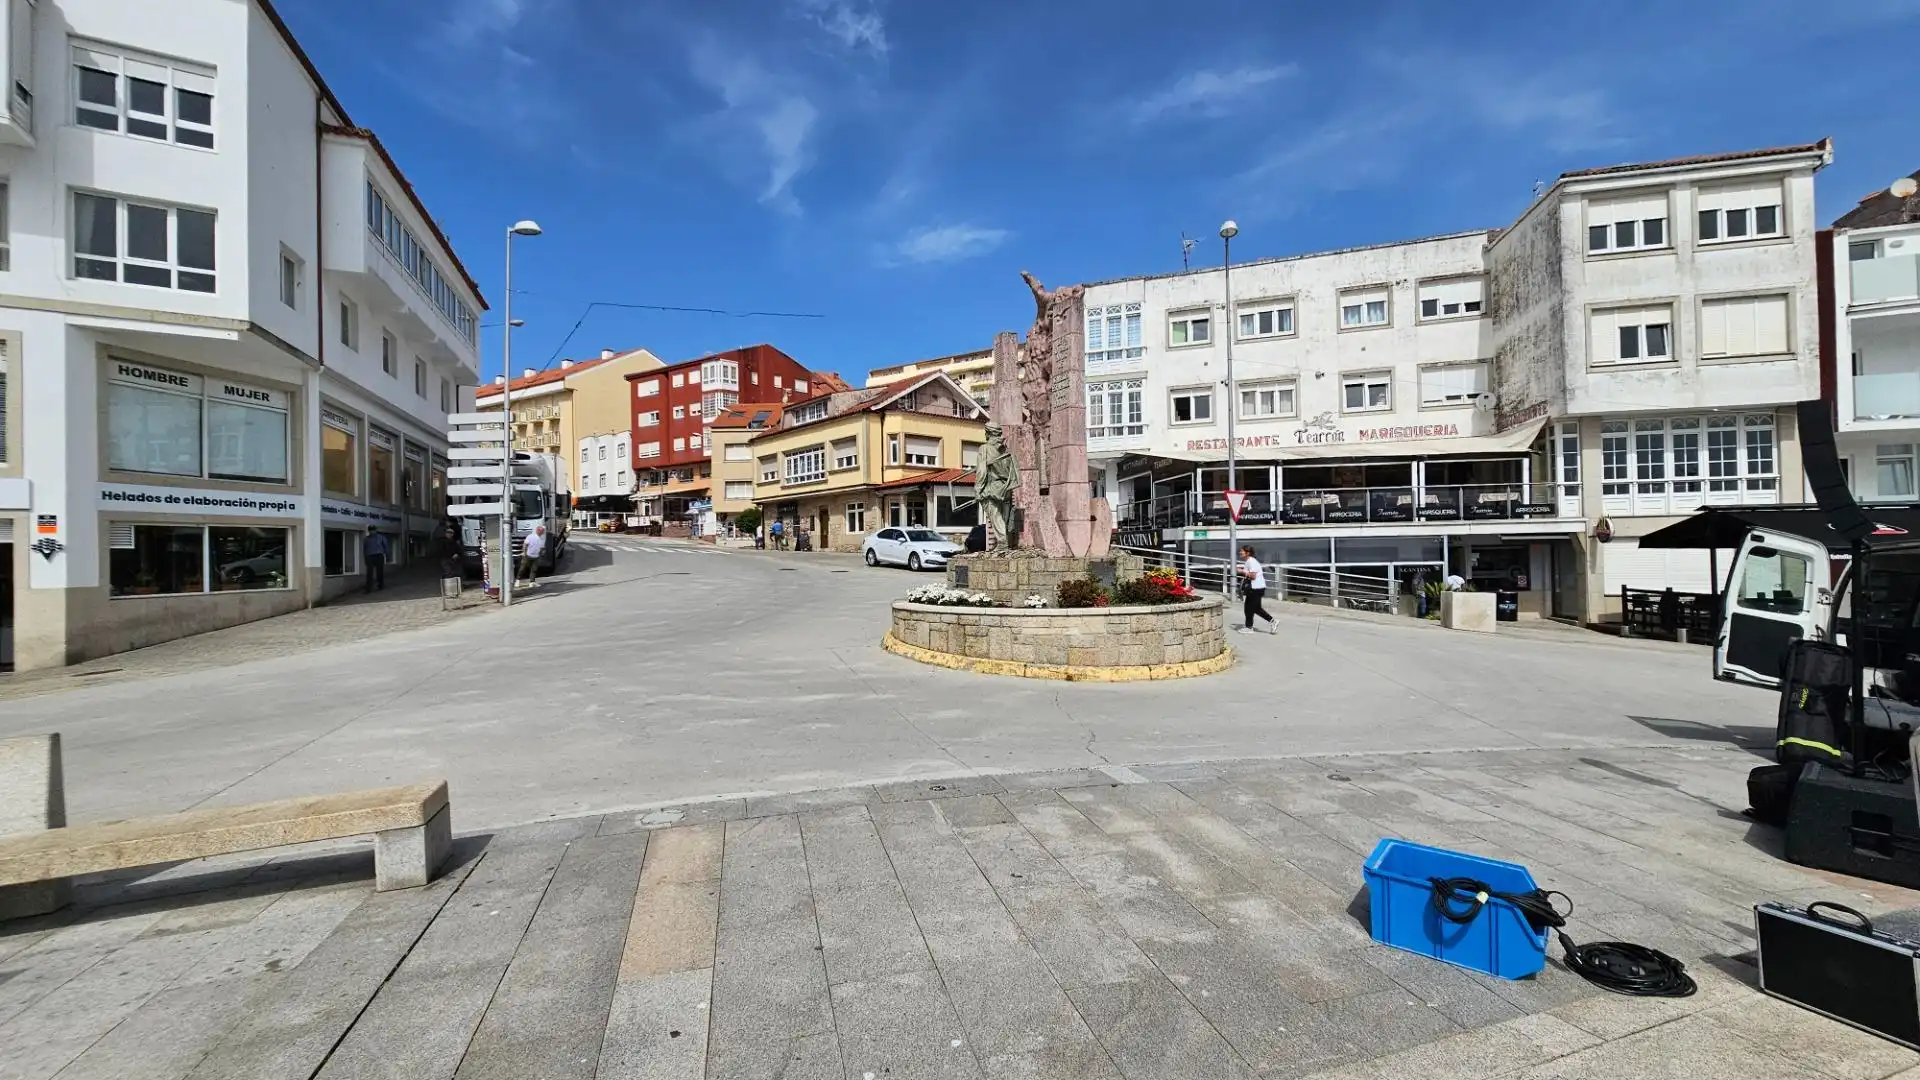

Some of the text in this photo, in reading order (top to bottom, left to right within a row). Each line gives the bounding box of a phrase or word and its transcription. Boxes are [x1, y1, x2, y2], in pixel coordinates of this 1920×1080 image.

[118, 364, 189, 388] HOMBRE
[224, 384, 271, 402] MUJER
[1186, 435, 1280, 451] RESTARANTE
[1359, 423, 1459, 441] MARISQUERIA
[101, 490, 161, 503] Helados
[164, 494, 181, 504] de
[183, 494, 257, 508] elaboración
[1123, 532, 1153, 546] CANTINA
